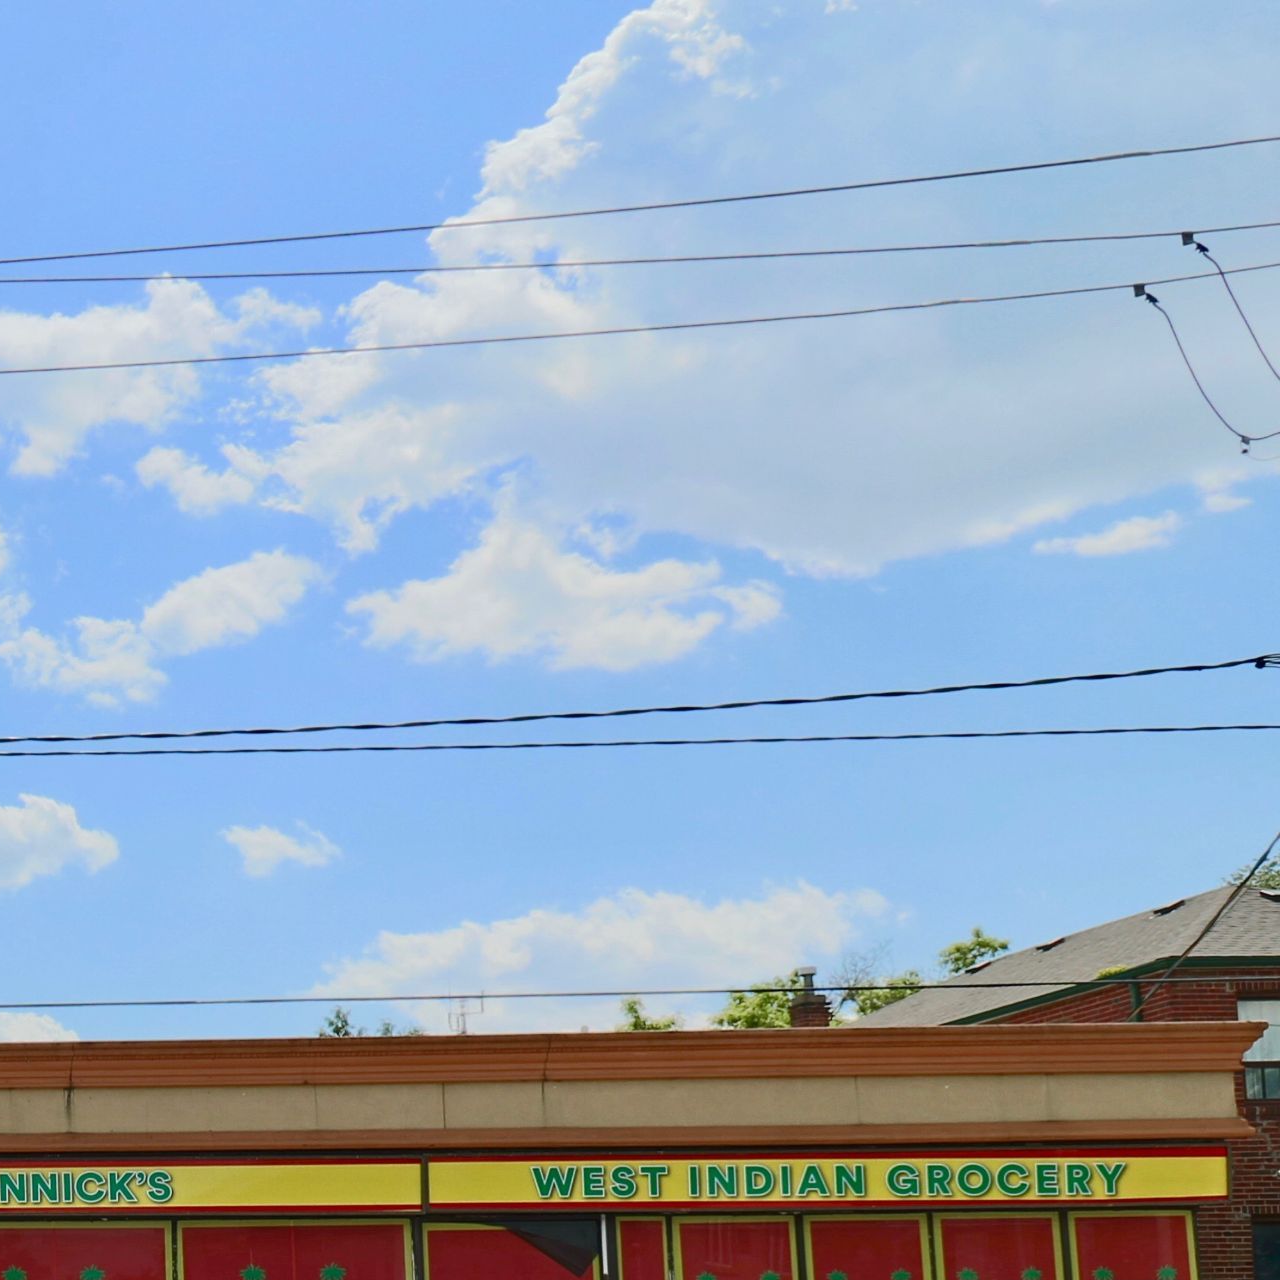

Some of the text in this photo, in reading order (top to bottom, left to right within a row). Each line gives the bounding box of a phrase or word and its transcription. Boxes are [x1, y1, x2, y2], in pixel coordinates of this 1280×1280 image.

[531, 1161, 1127, 1198] WEST INDIAN GROCERY
